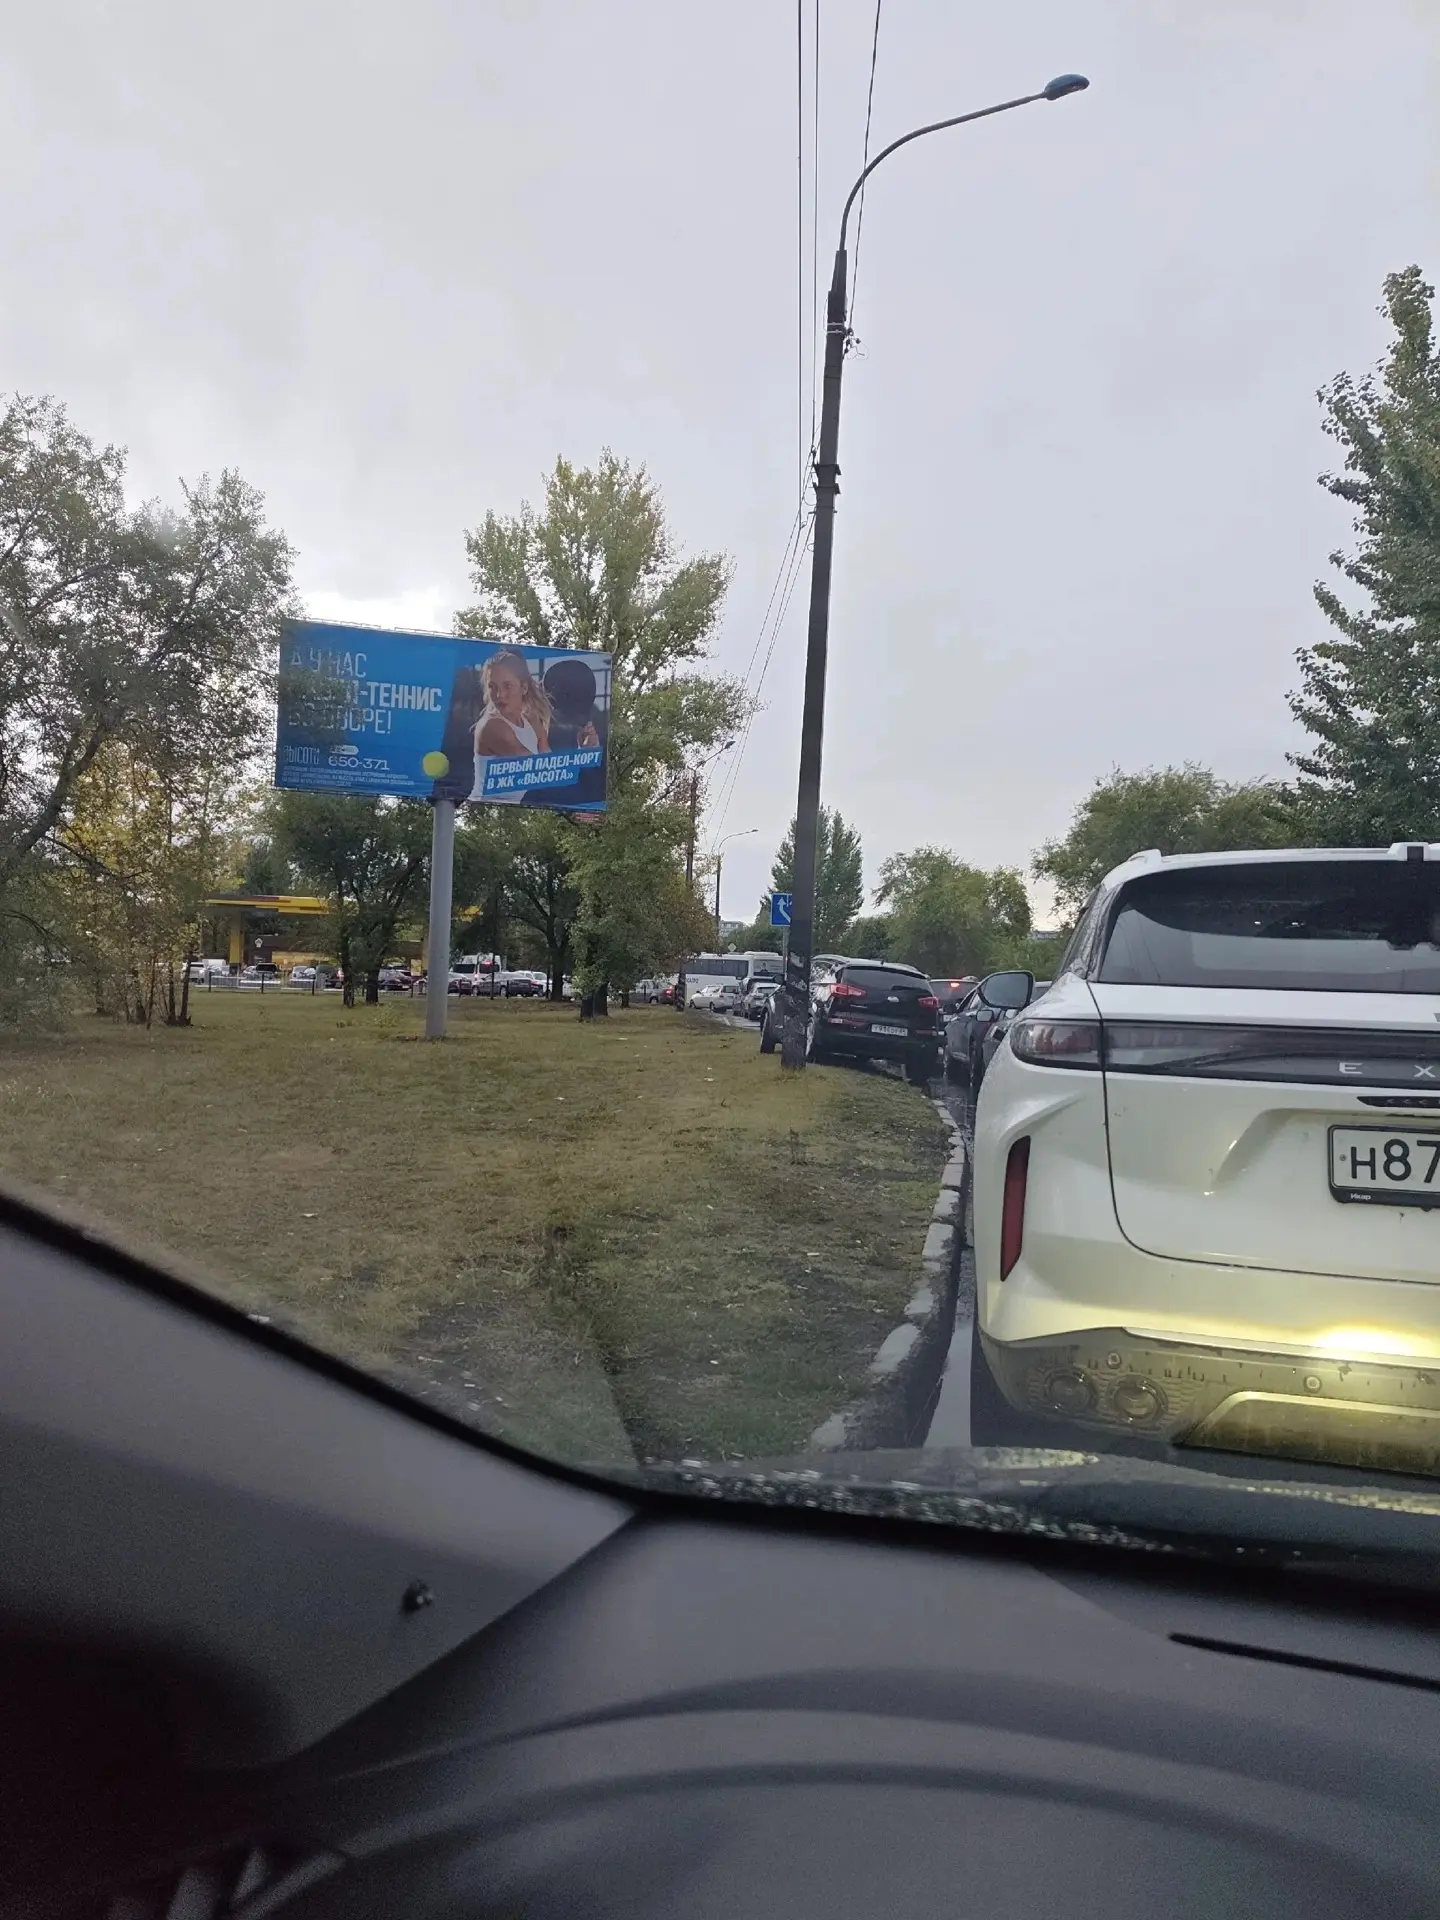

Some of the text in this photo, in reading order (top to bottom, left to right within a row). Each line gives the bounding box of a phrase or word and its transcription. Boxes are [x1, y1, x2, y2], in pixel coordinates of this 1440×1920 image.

[309, 647, 322, 673] У
[329, 651, 367, 678] НАС
[328, 755, 390, 771] 650-371
[488, 751, 601, 776] ПЕРВЫЙ ПАДЕЛ-КОРТ
[486, 769, 574, 790] В ЖК «ВЫСОТА»
